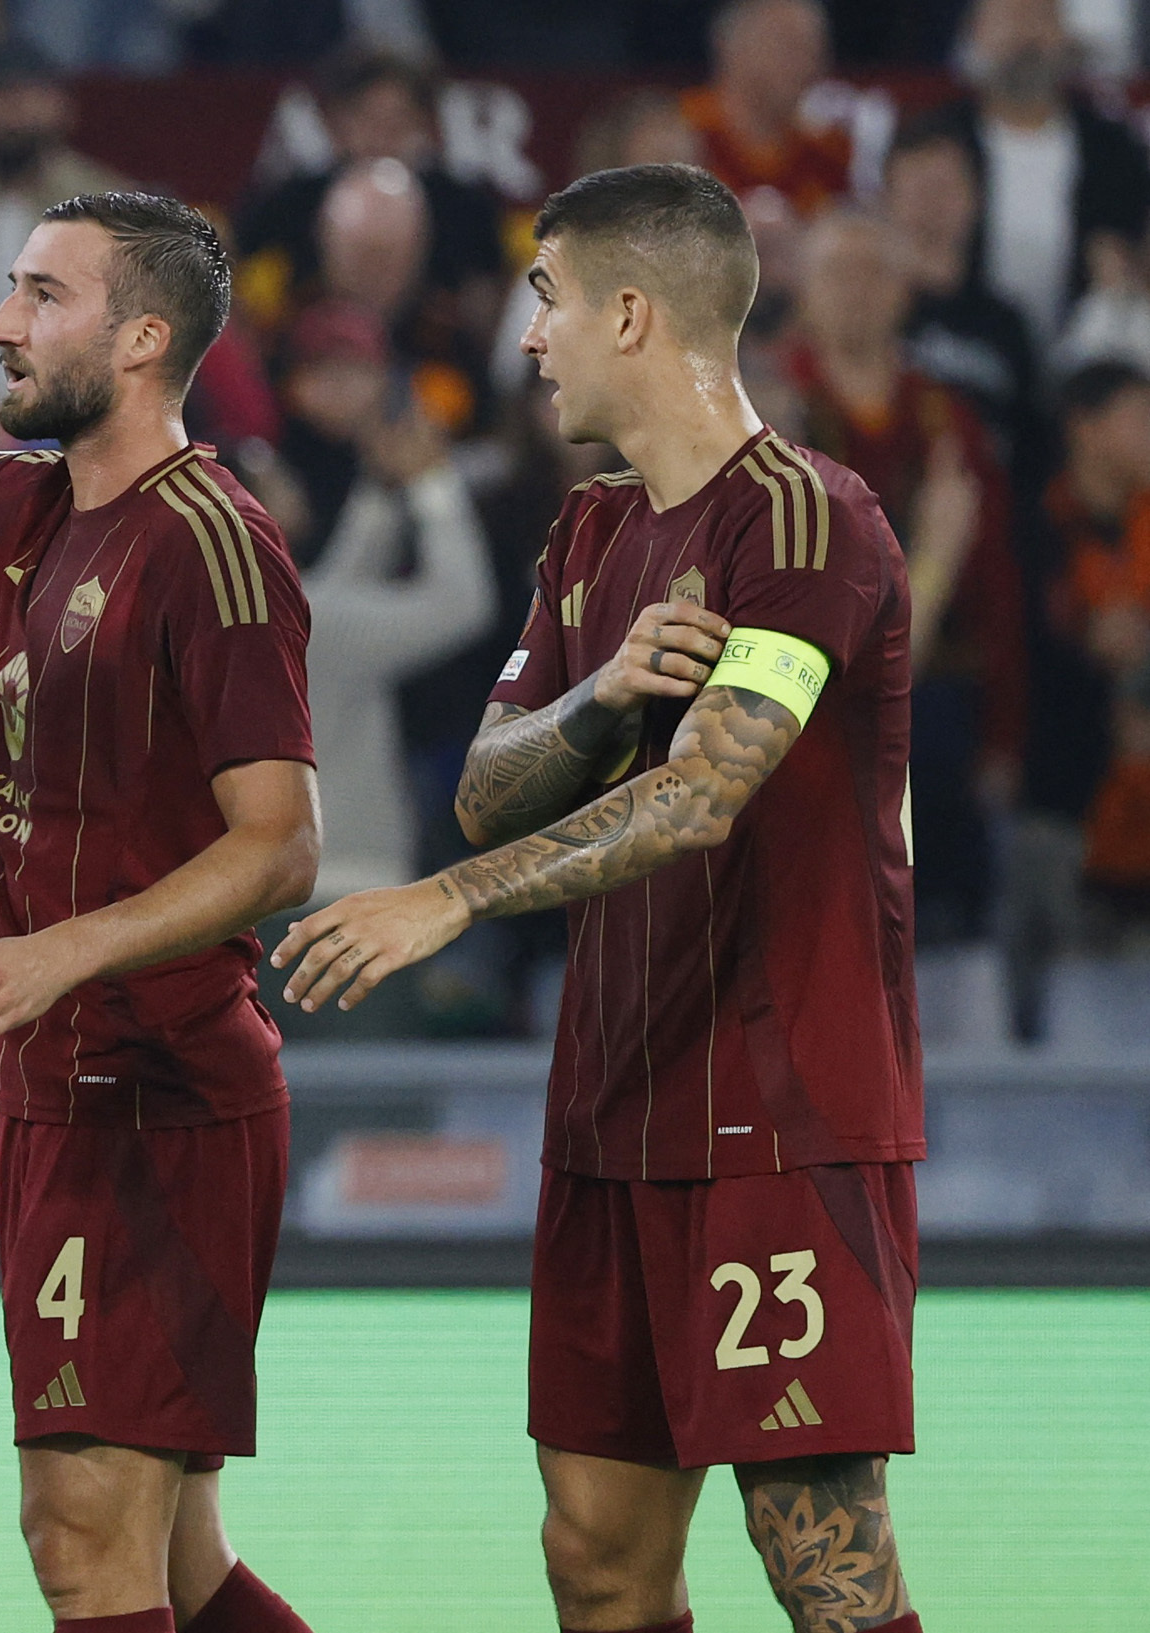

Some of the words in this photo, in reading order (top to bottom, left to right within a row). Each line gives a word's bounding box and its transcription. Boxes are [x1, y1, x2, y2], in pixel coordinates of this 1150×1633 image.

[78, 1075, 117, 1084] AEROREADY
[717, 1125, 753, 1135] AEROREADY
[35, 1236, 85, 1340] 4
[709, 1249, 825, 1371] 23
